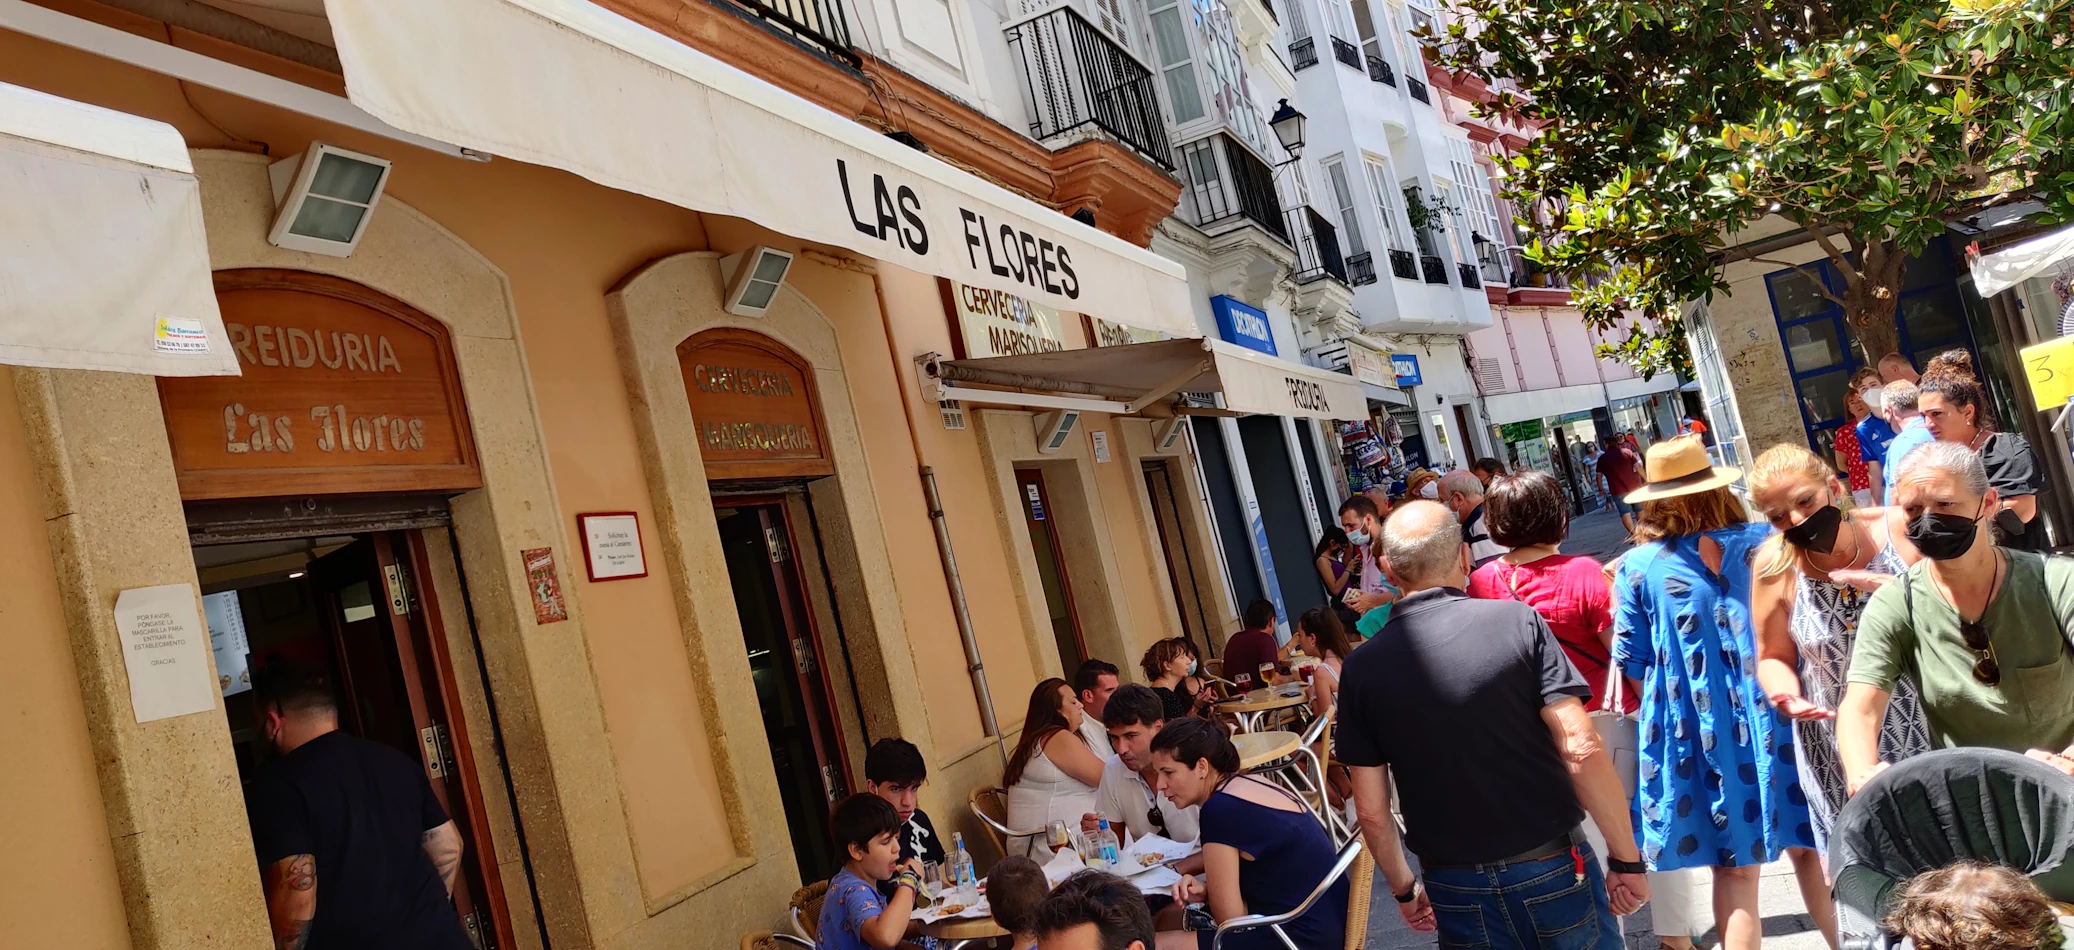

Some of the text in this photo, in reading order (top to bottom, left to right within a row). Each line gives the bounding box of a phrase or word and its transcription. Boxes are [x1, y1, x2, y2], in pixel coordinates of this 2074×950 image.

[837, 159, 1080, 300] LAS FLORES
[962, 284, 1038, 328] CERVECERIA
[1230, 308, 1270, 342] DECATHLON
[227, 322, 401, 374] REIDURIA
[694, 364, 794, 397] CERVECERIA
[2029, 354, 2053, 383] 3
[223, 402, 424, 453] Las Flores
[702, 421, 813, 452] MARISQUERIA
[131, 627, 167, 636] MASCARILLA
[143, 634, 167, 642] ENTRAR
[150, 658, 176, 666] GRACIAS
